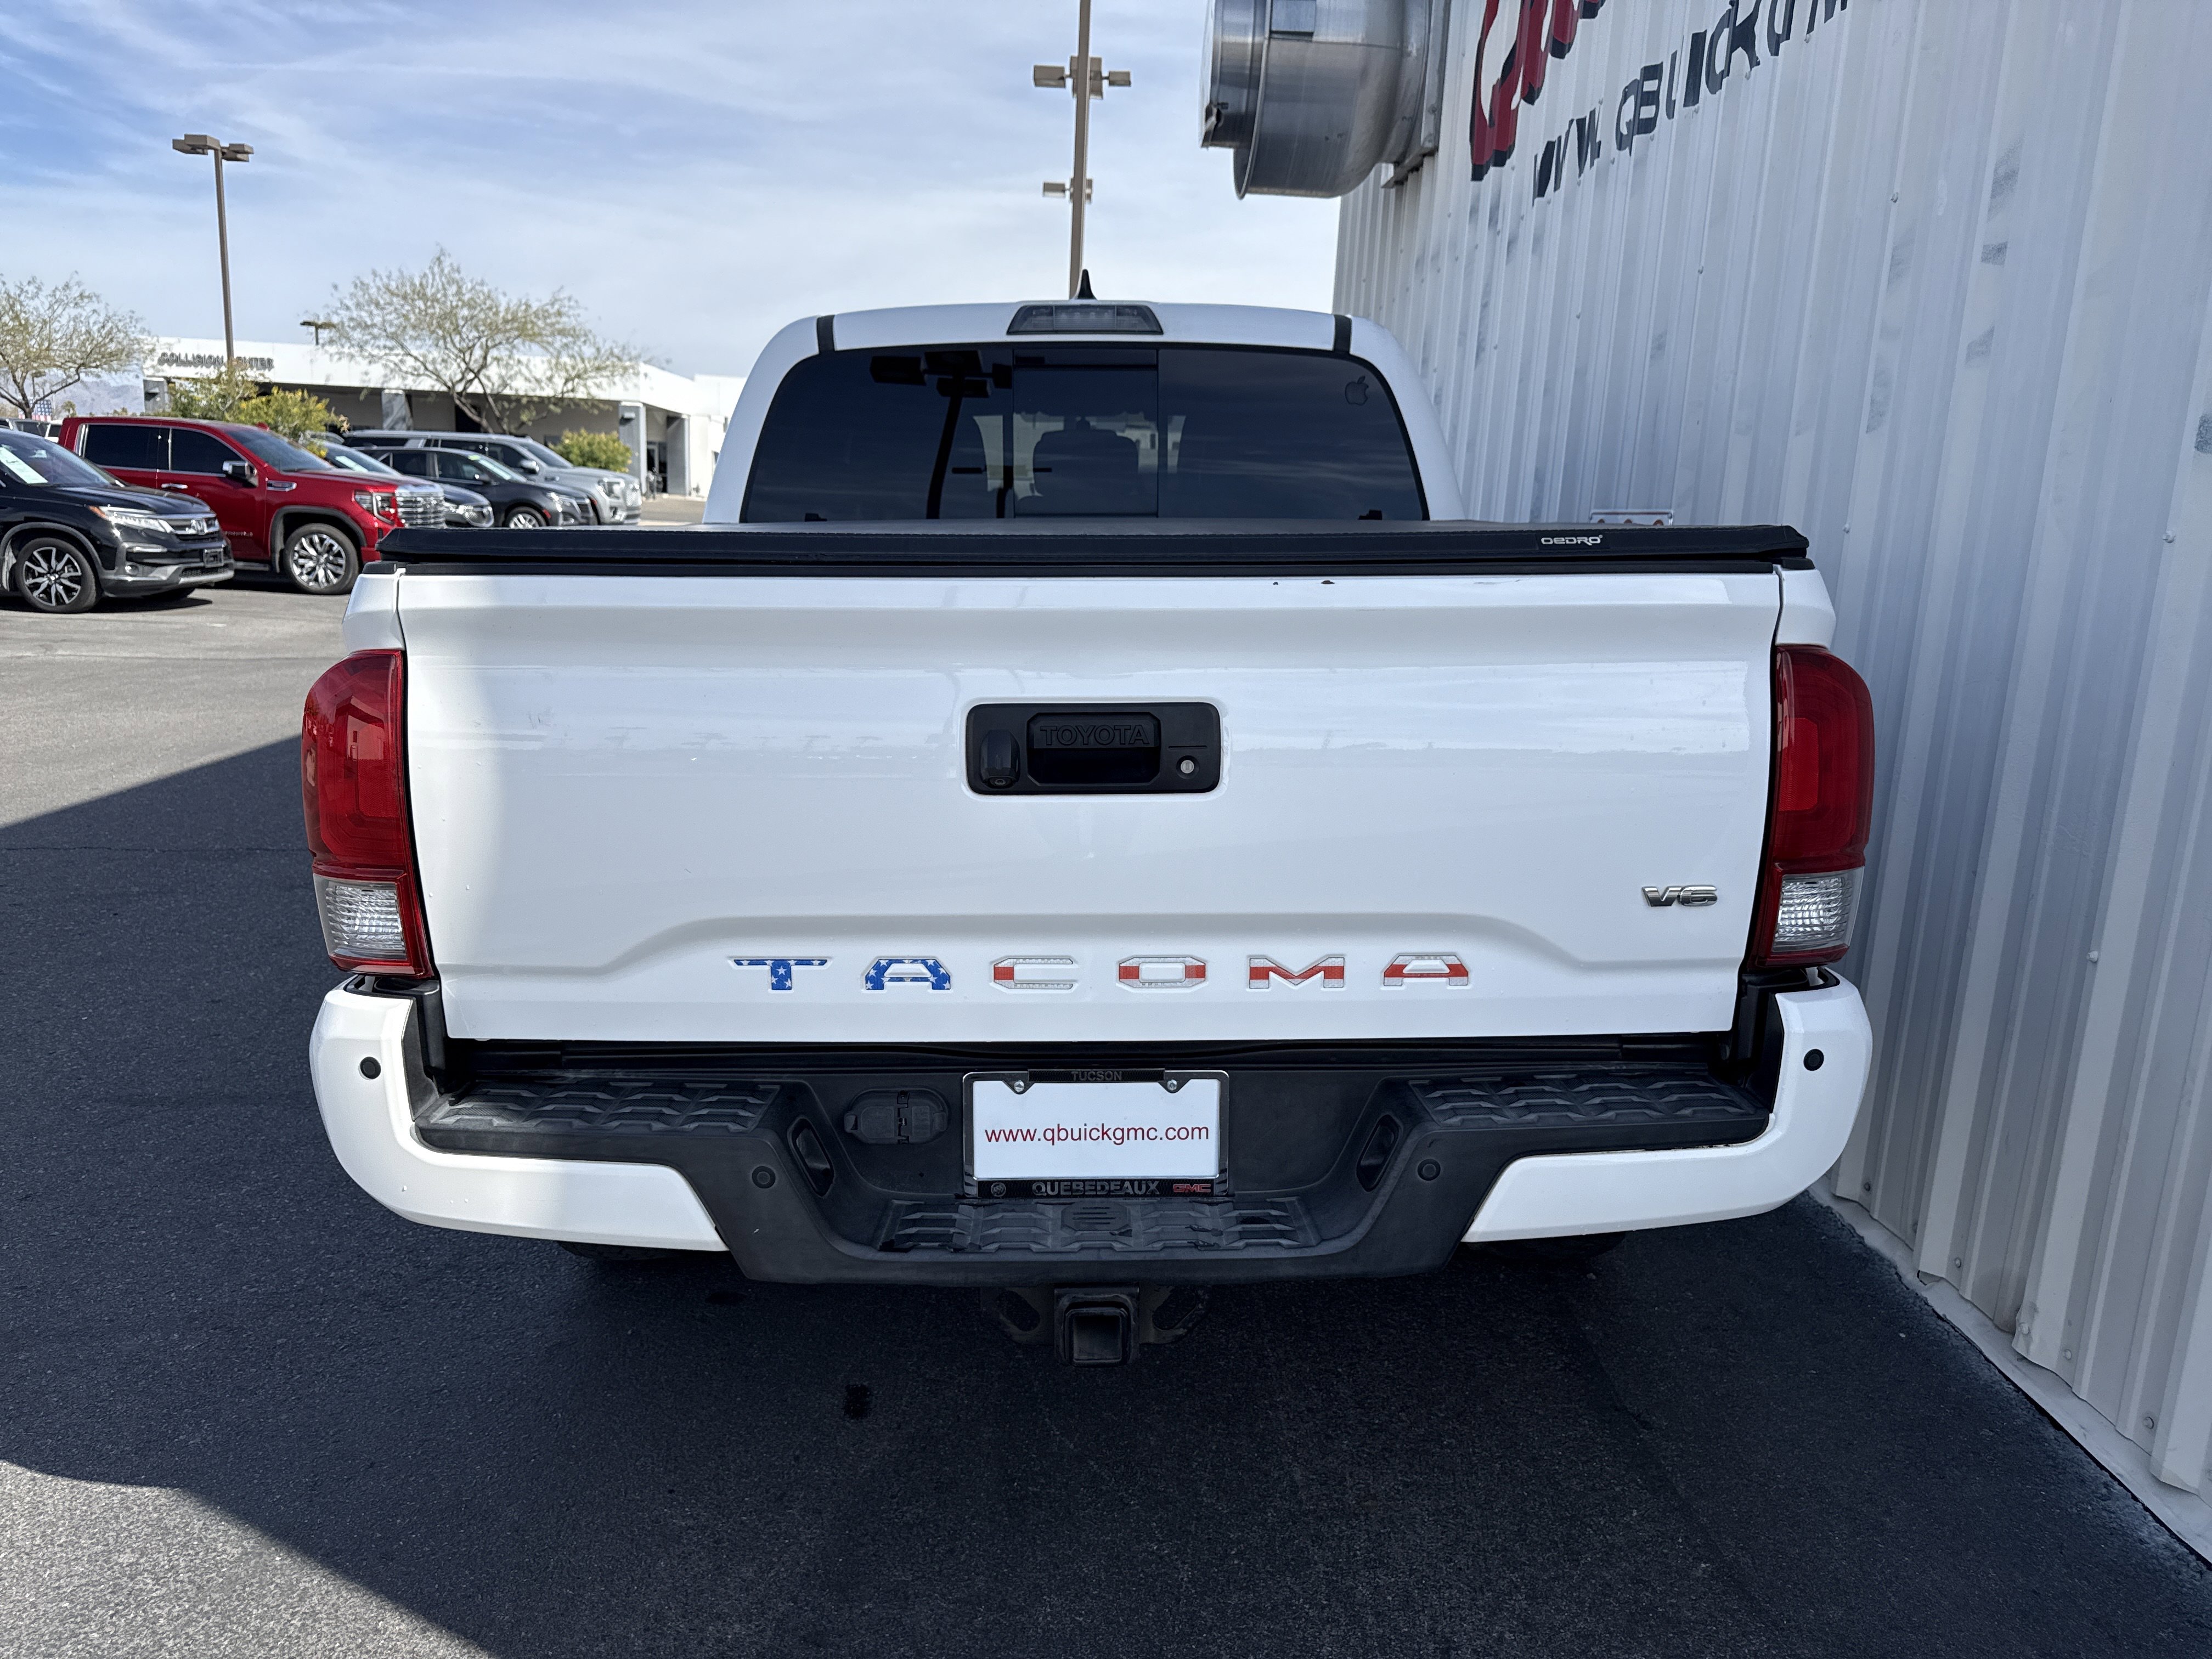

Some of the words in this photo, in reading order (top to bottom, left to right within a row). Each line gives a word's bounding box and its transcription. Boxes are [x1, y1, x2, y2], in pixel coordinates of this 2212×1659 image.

[159, 352, 225, 368] COLLISION
[227, 356, 275, 371] ENTER
[1040, 724, 1150, 746] TOYOTA
[1642, 885, 1717, 907] V6
[727, 955, 1470, 991] TACOMA
[1071, 1070, 1122, 1082] TUCSON
[985, 1124, 1209, 1146] www.qbuickgmc.com
[1031, 1181, 1159, 1195] QUEBEDEAUX
[1173, 1183, 1211, 1193] GMC
